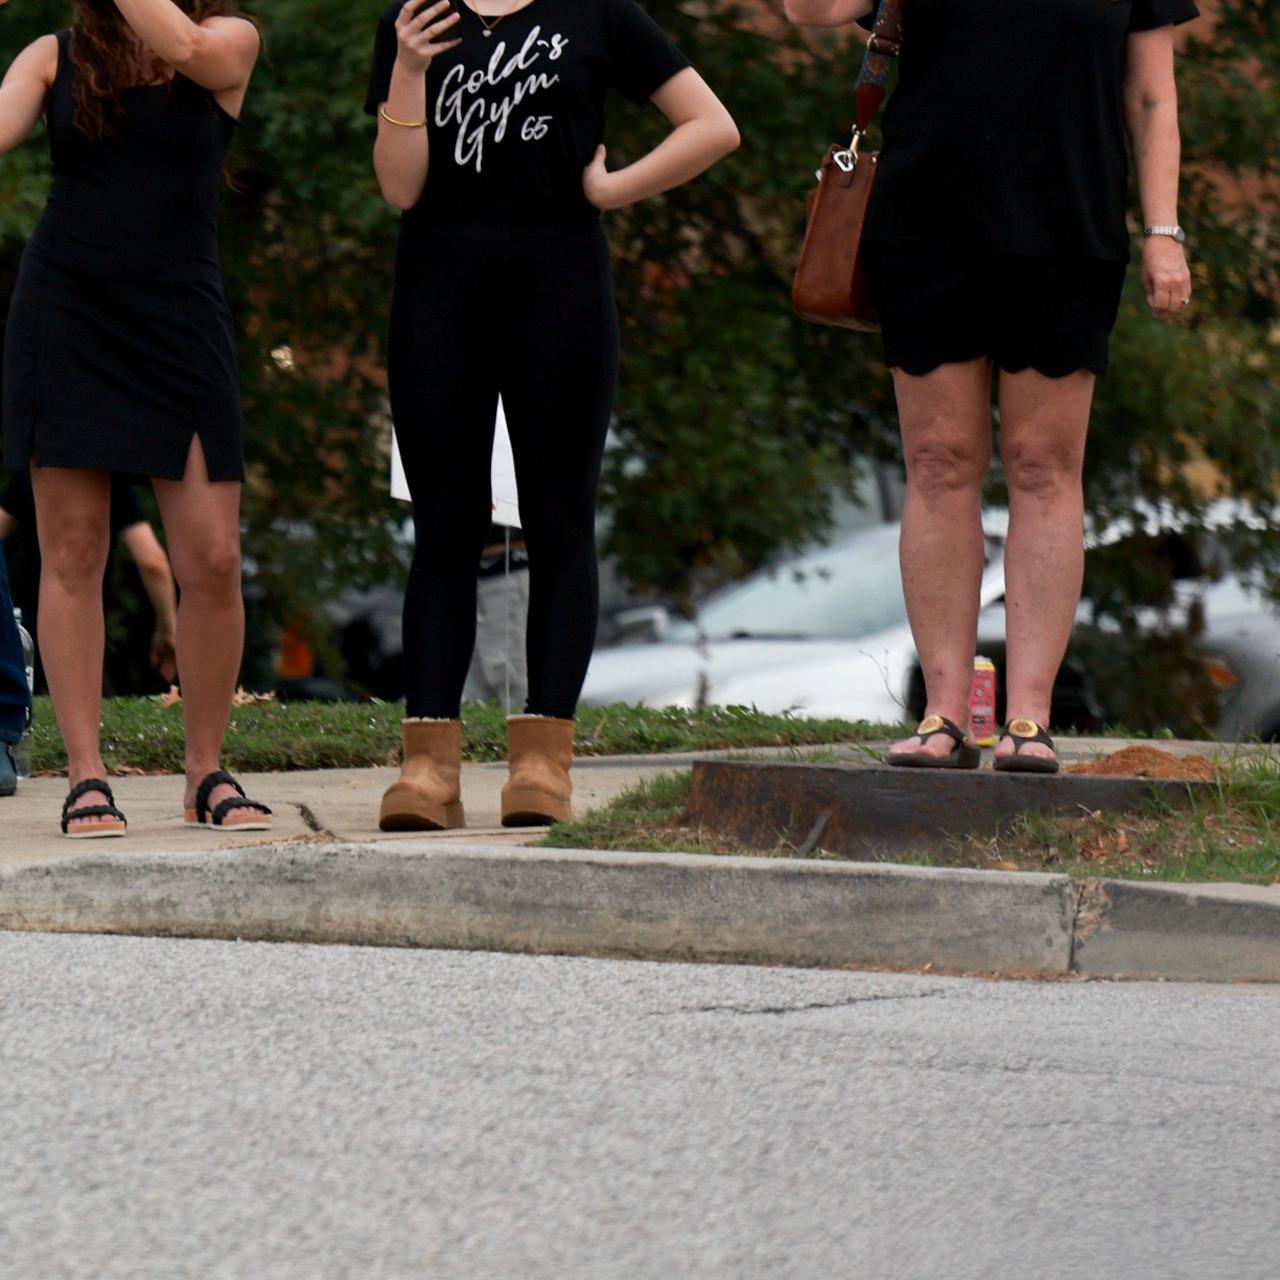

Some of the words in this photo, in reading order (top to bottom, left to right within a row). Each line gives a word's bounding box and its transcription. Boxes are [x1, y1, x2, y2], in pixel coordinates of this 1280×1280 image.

[435, 24, 569, 127] Gold's
[454, 72, 560, 173] Gym
[521, 116, 553, 141] 65
